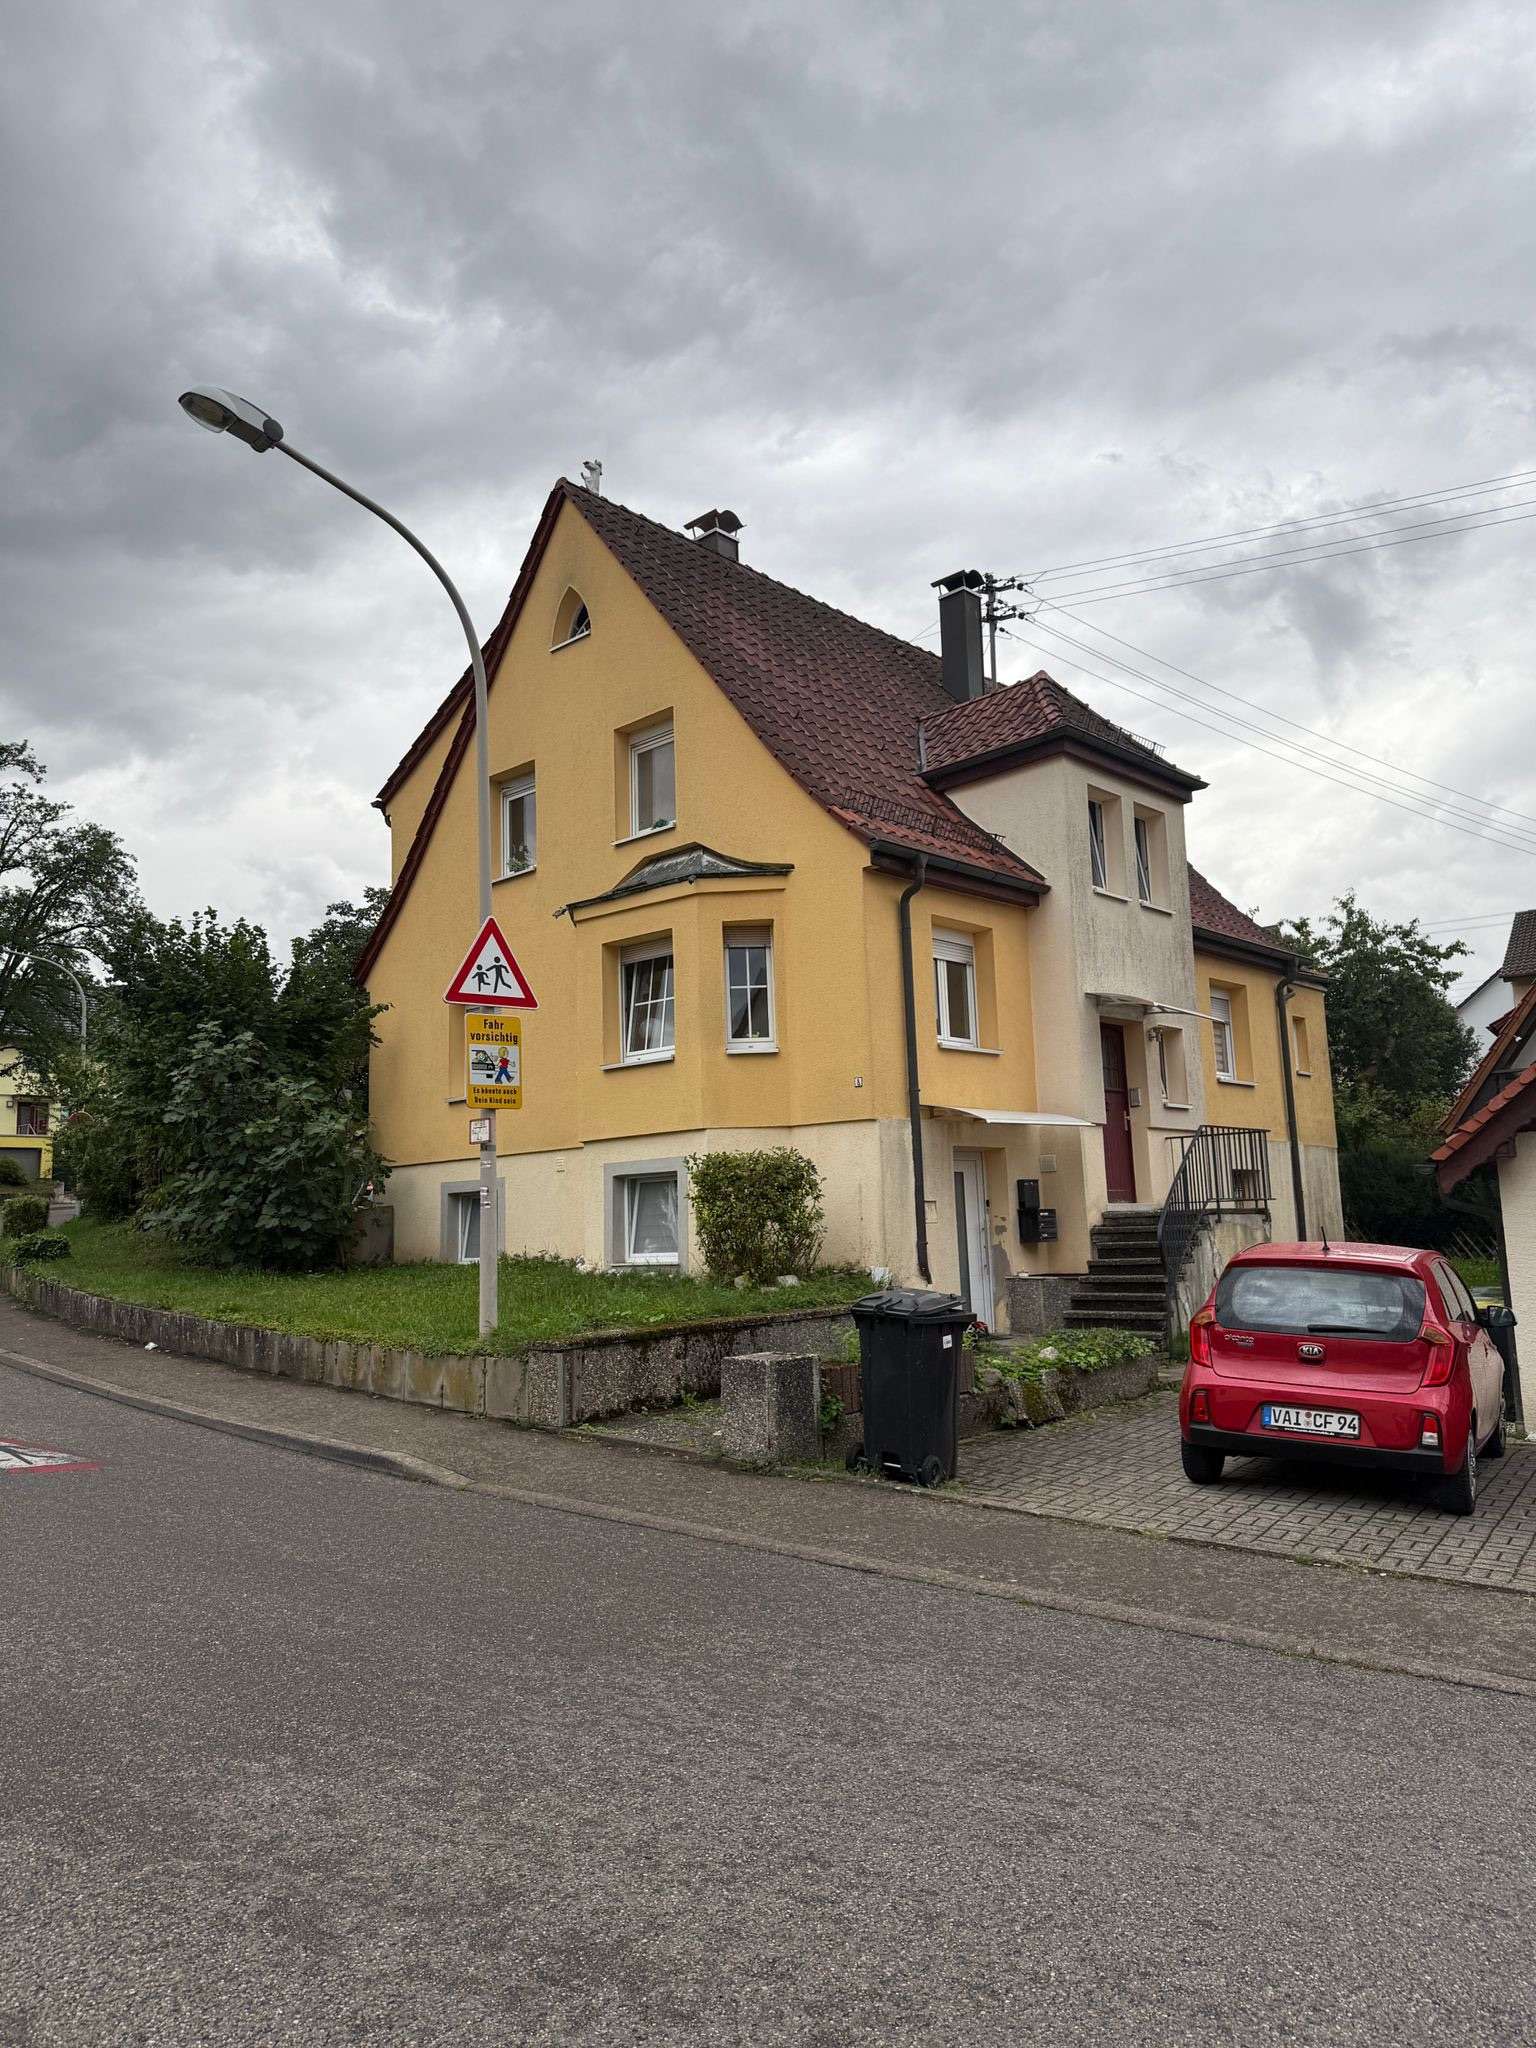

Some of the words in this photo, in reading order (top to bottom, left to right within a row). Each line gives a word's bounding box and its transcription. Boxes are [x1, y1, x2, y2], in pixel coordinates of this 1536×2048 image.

[483, 1019, 504, 1030] Fahr
[470, 1032, 518, 1045] vorsichtig
[1302, 1345, 1320, 1356] KIA
[1272, 1408, 1302, 1427] VAI
[1313, 1413, 1334, 1429] CF
[1337, 1416, 1358, 1433] 94
